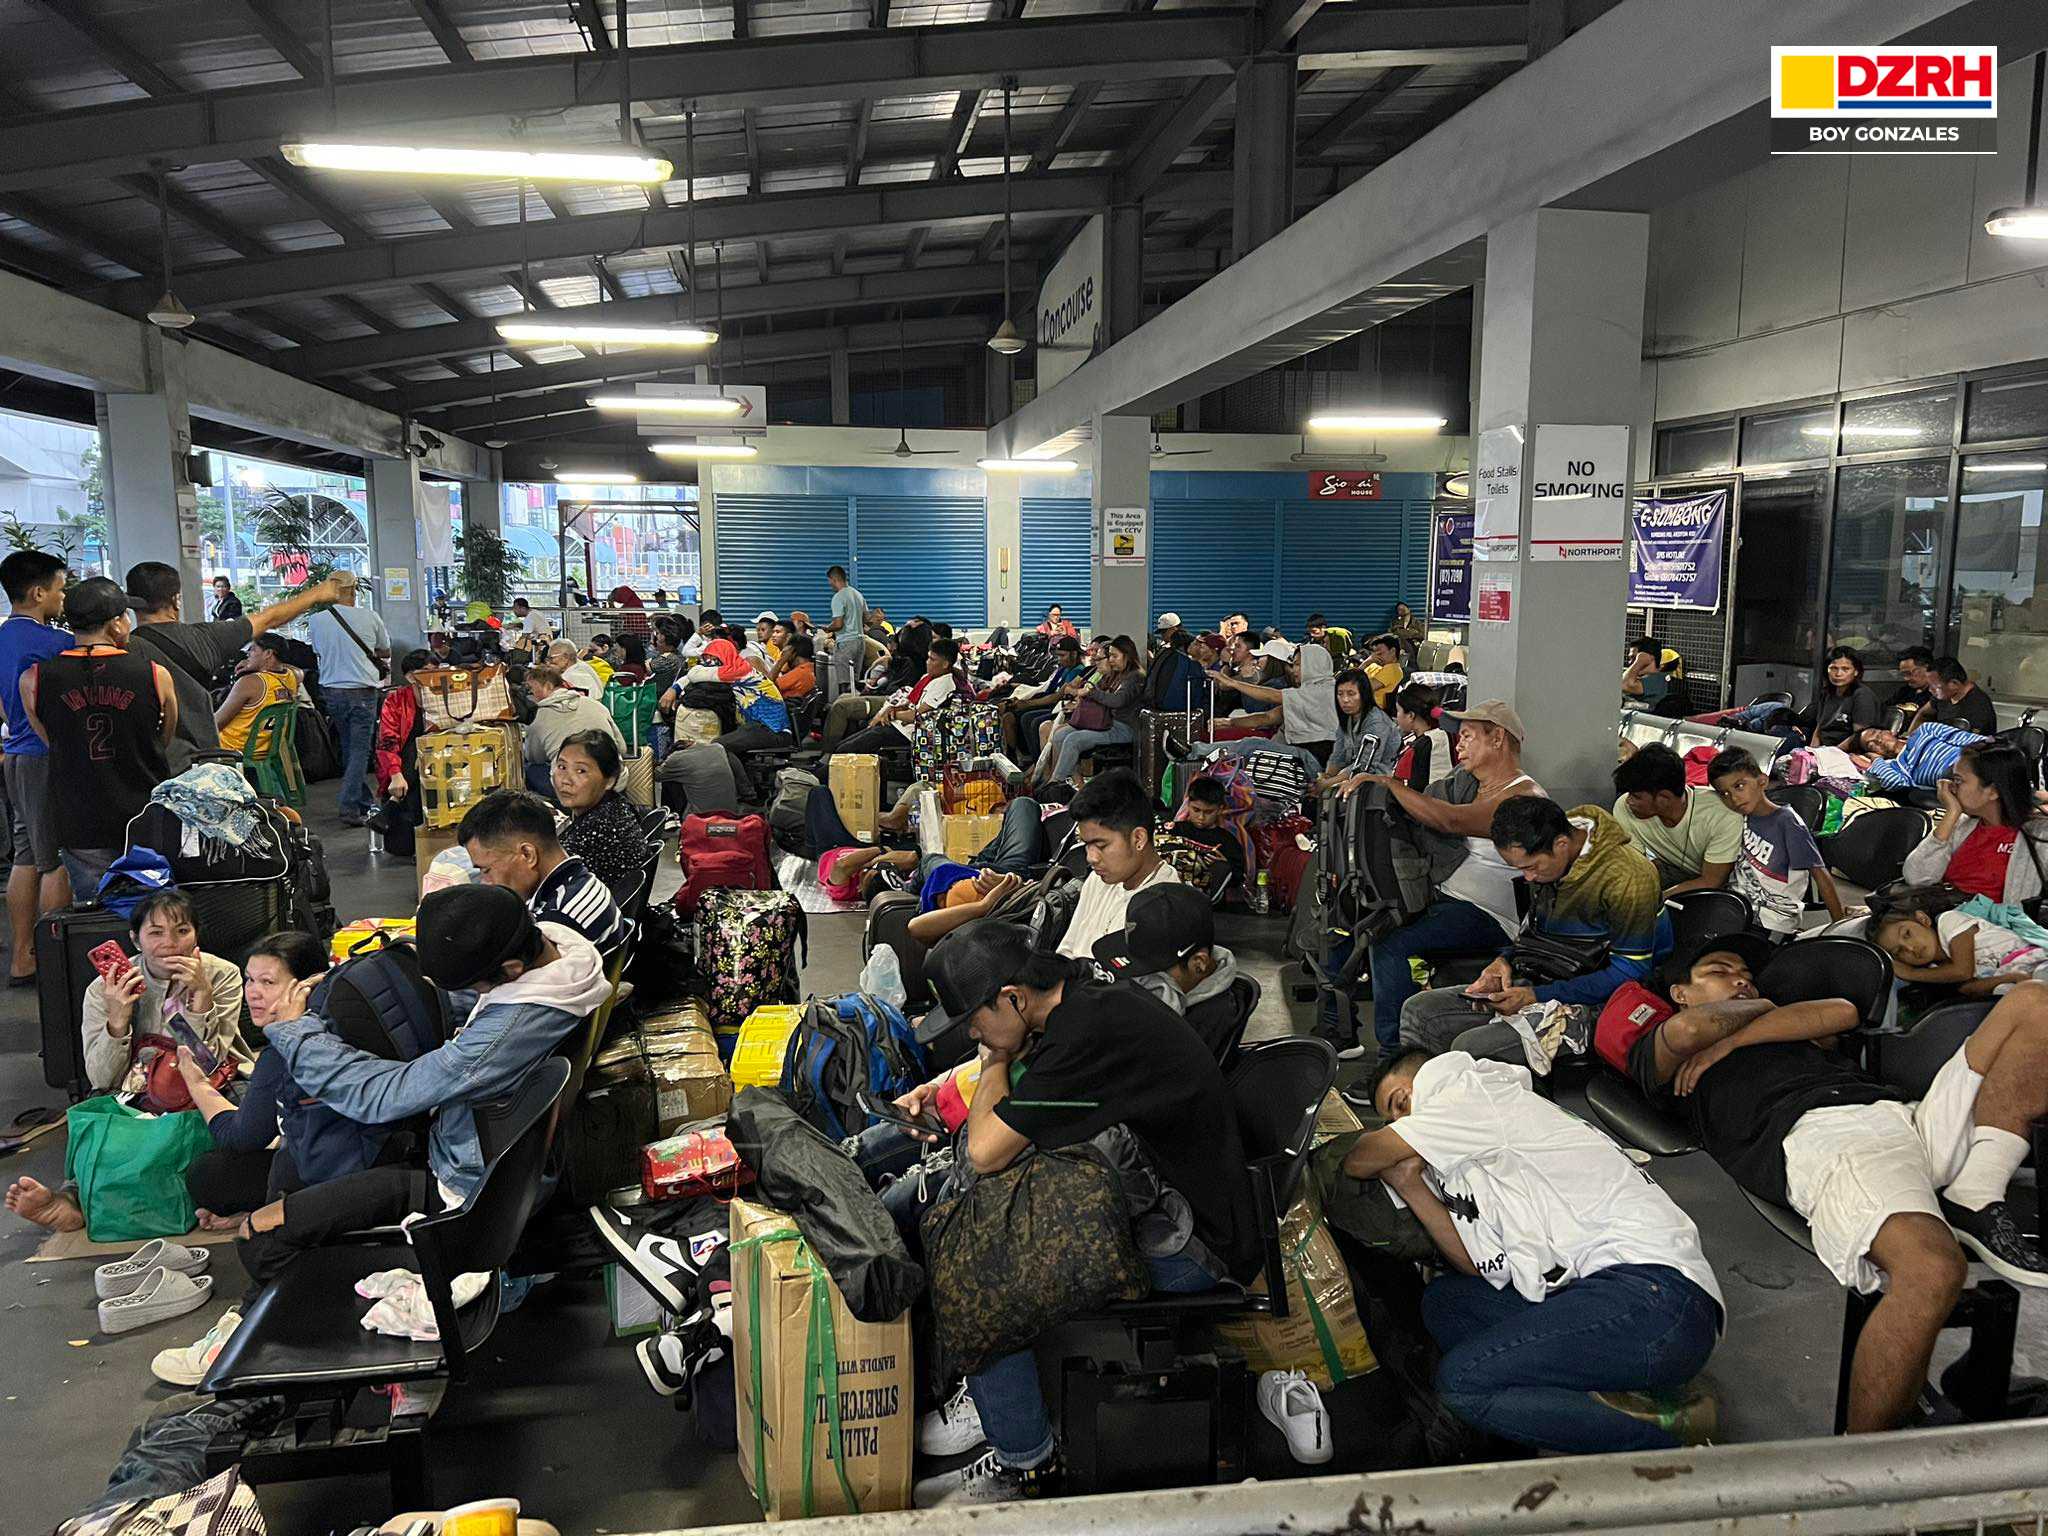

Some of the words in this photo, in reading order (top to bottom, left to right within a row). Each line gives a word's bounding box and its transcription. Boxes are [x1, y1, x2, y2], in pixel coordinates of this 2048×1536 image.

[1043, 275, 1093, 346] Concourse
[1478, 468, 1495, 480] Food
[1567, 460, 1595, 477] NO
[1487, 483, 1509, 495] Toilets
[1534, 482, 1624, 499] SMOKING
[1567, 548, 1621, 557] NORTHPORT
[86, 712, 115, 761] 2
[860, 1355, 896, 1374] HANDLE
